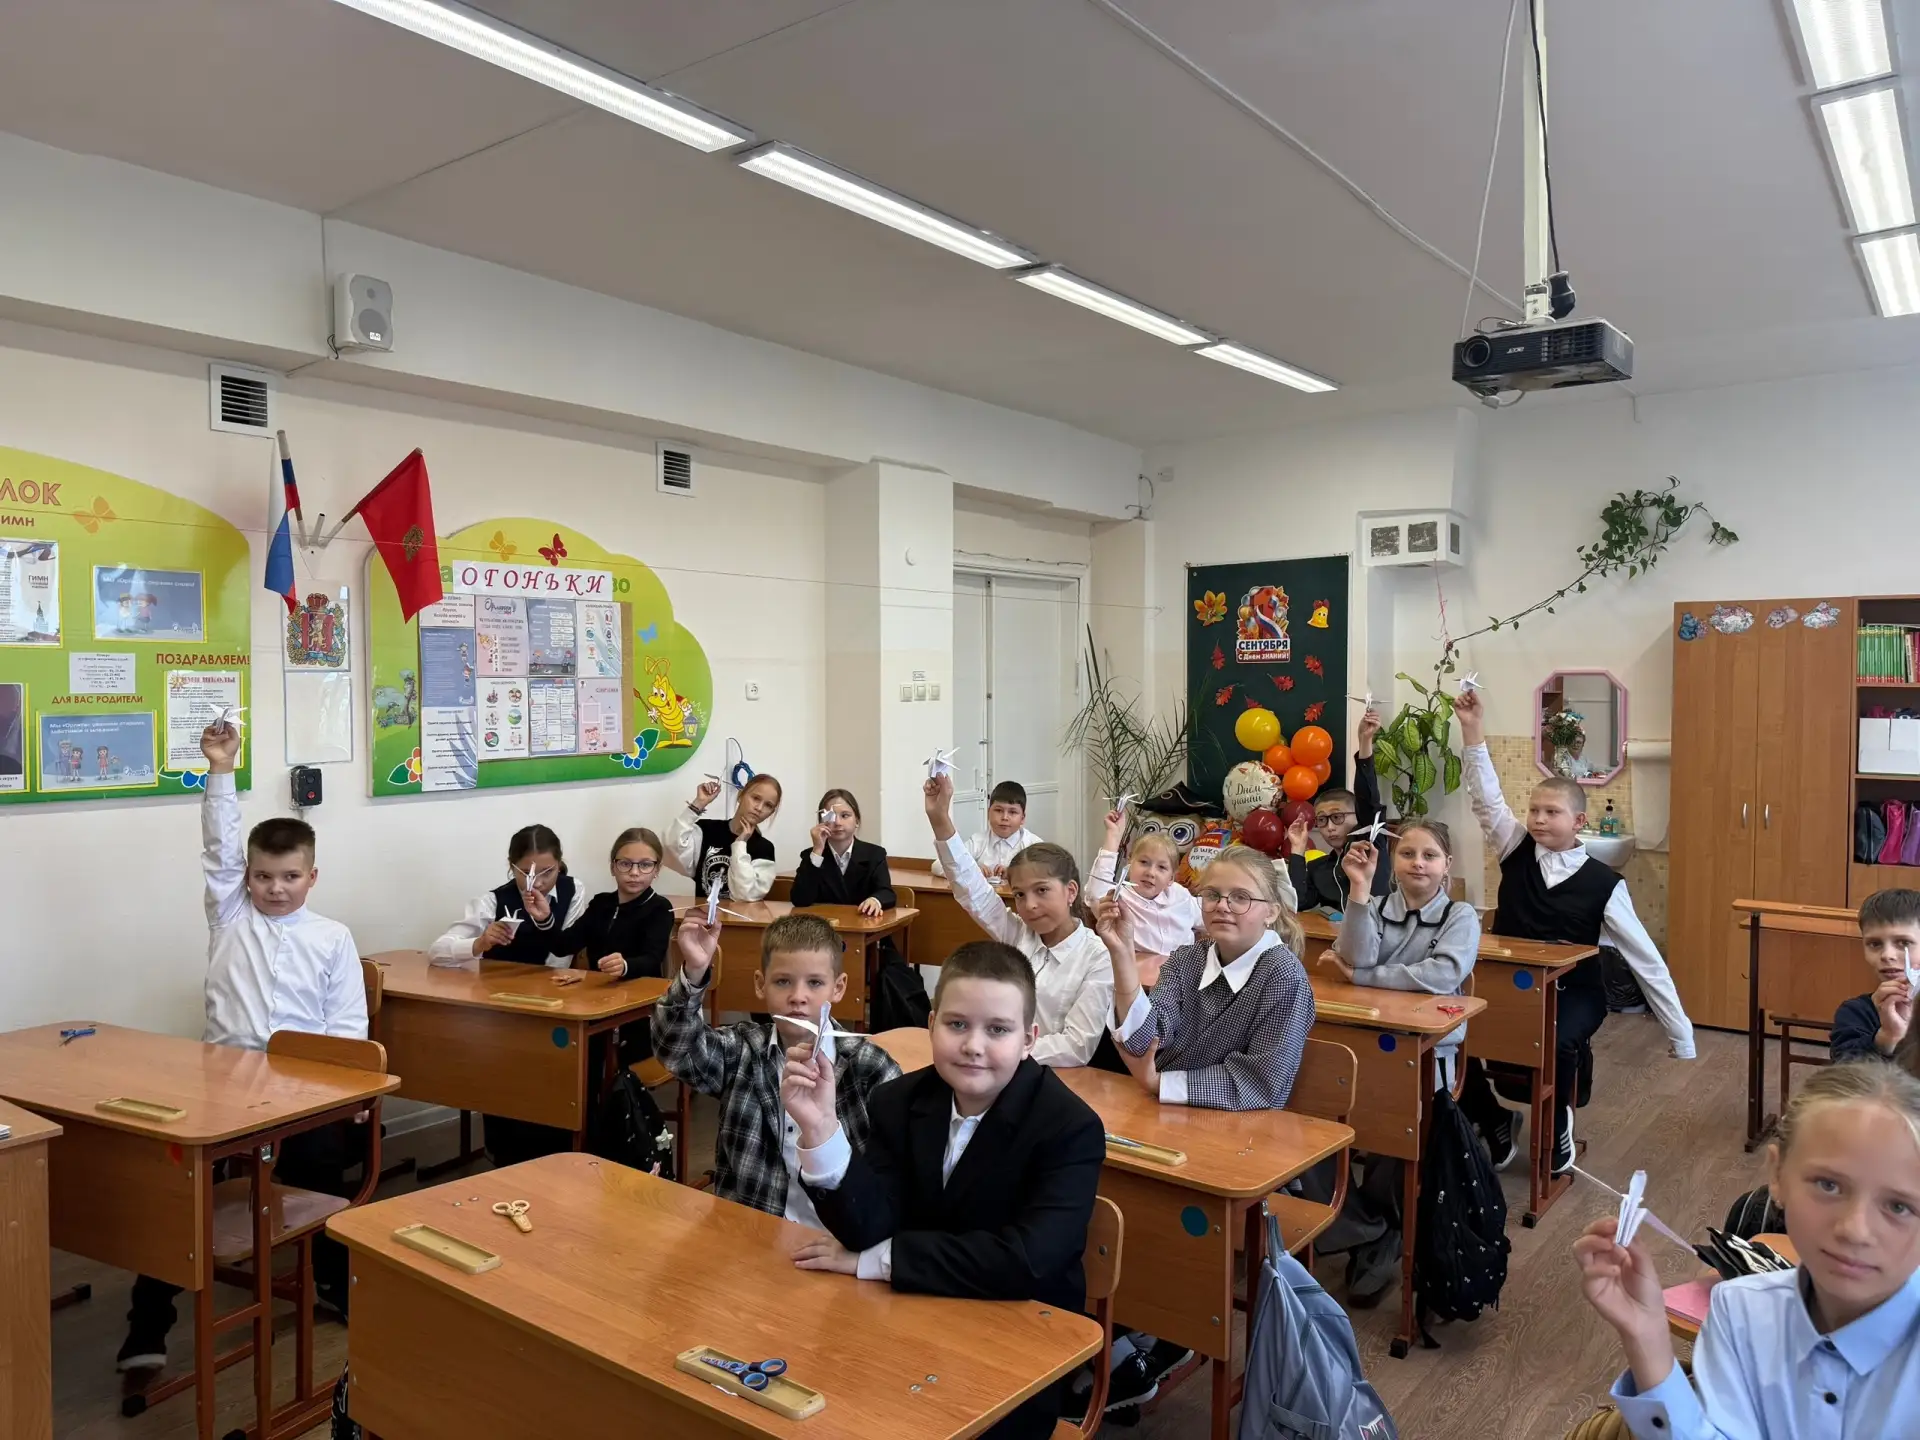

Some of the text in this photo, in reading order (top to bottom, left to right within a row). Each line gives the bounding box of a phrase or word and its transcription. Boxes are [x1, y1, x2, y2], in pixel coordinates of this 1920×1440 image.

[462, 567, 605, 596] ОГОНЬКИ
[1238, 640, 1288, 650] СЕНТЯБРЯ
[156, 653, 250, 666] ПОЗДРАВЛЯЕМ!
[52, 695, 143, 704] ДЛЯ ВАС РОДИТЕЛИ
